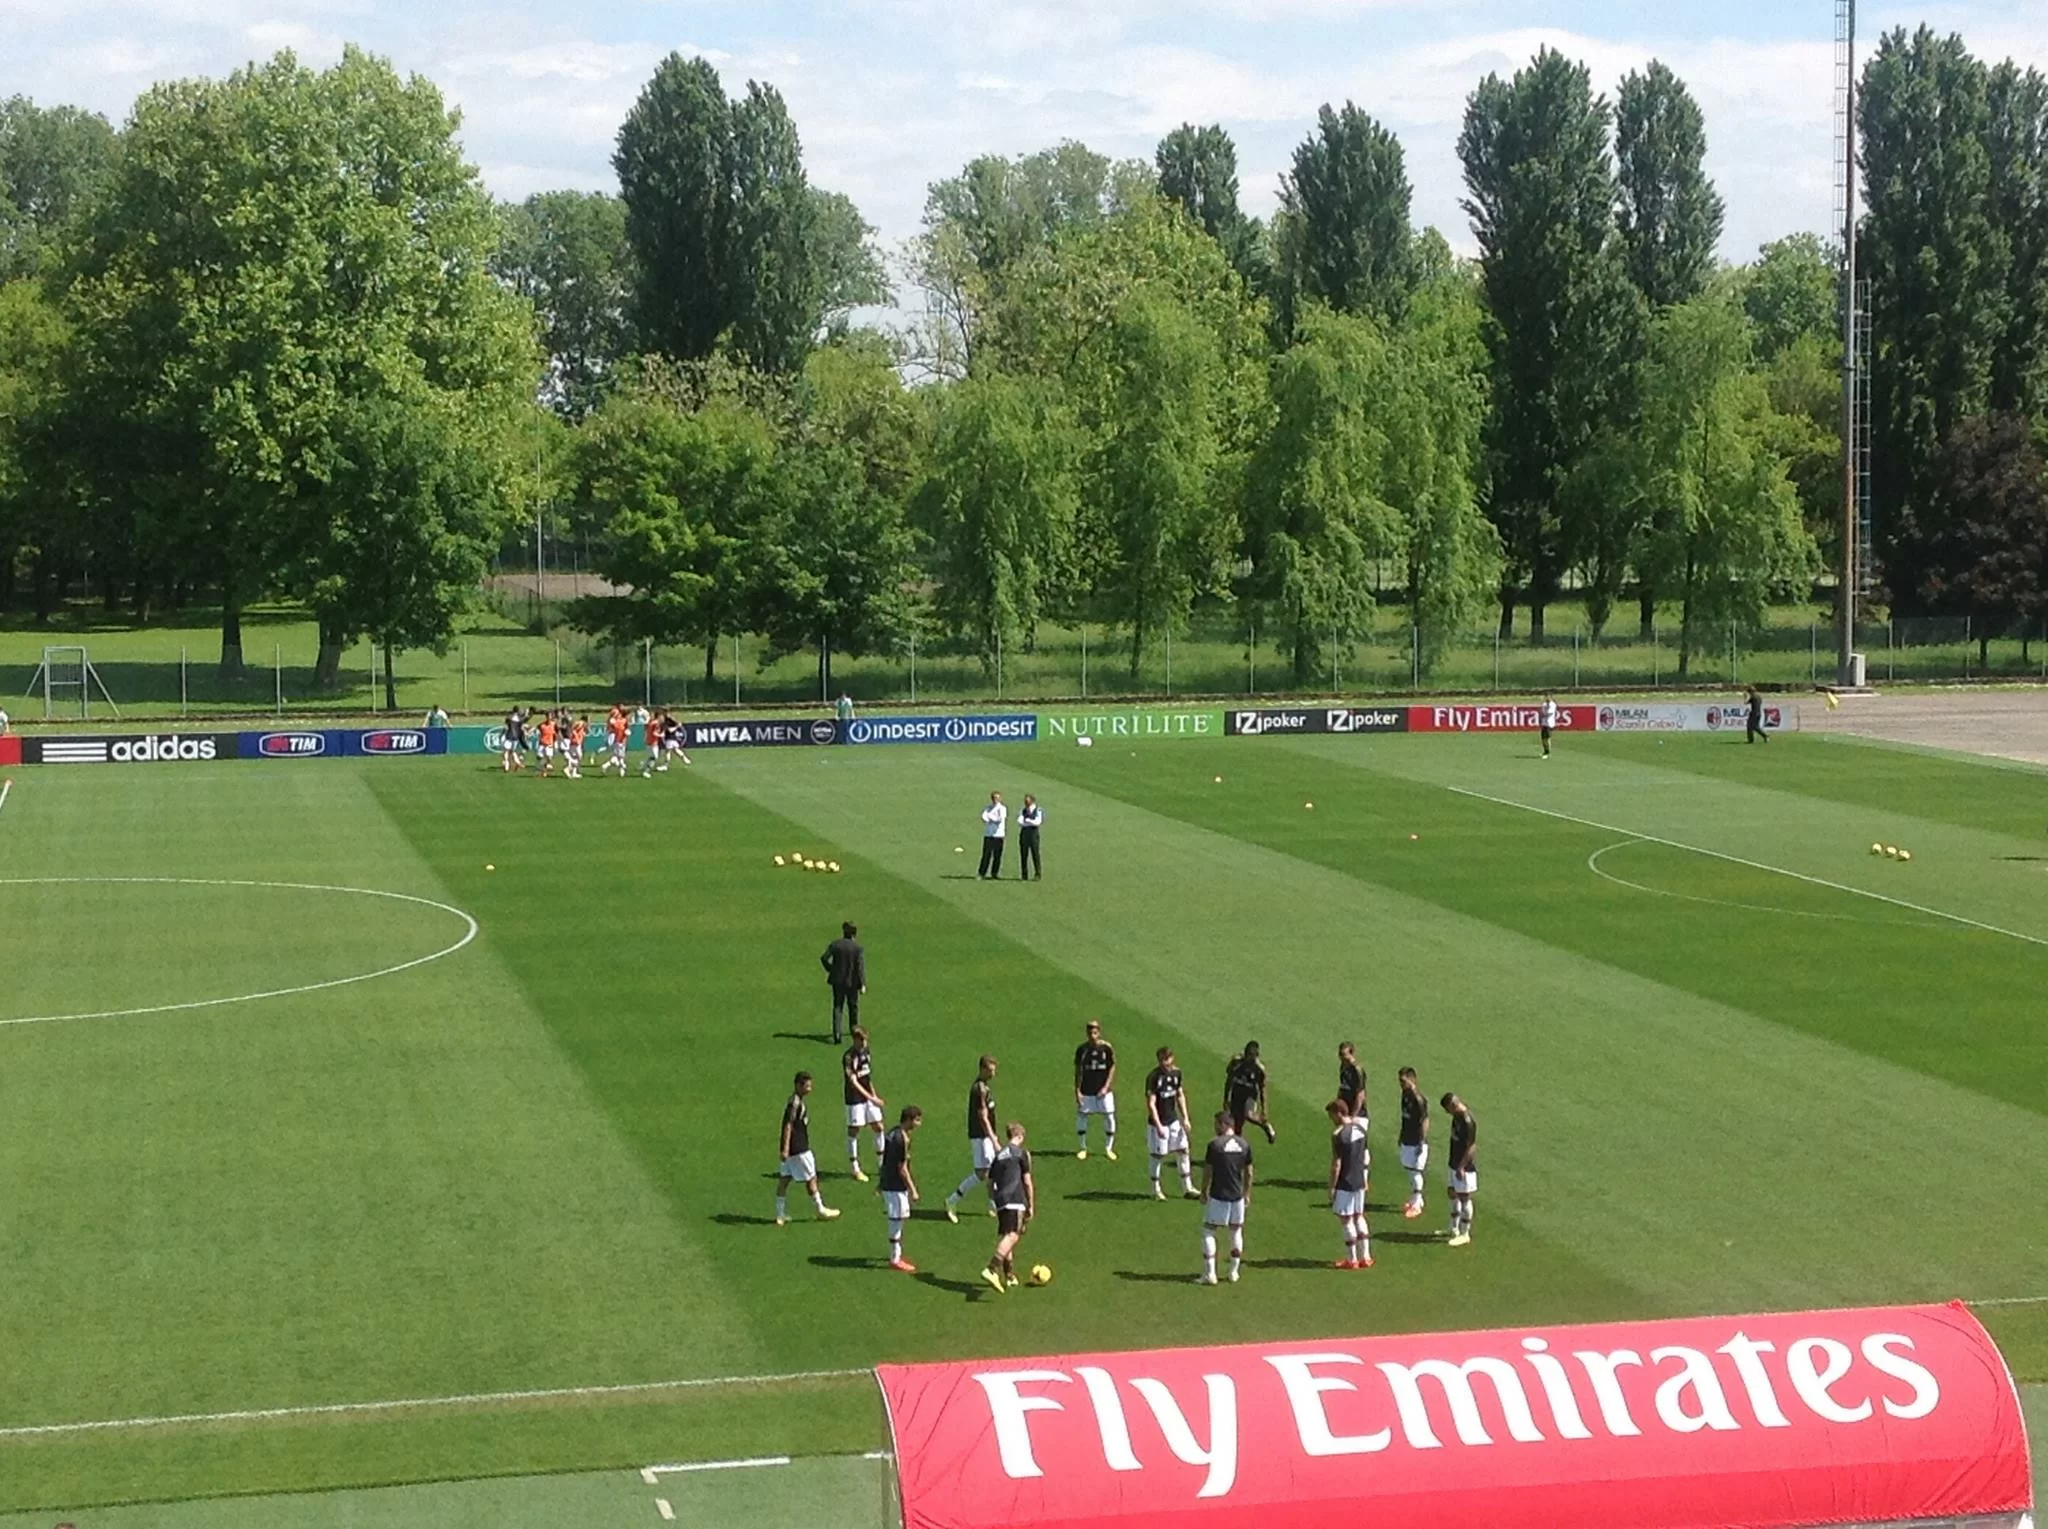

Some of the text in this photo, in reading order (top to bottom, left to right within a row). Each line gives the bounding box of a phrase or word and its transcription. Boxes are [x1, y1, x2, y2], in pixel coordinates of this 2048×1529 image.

[1049, 715, 1210, 736] NUTRILITE
[1434, 706, 1572, 731] Fly Emiraes
[289, 737, 317, 751] TIM
[391, 735, 418, 749] TIM
[696, 727, 751, 743] NIVEA
[756, 726, 801, 741] MEN
[111, 735, 216, 760] adidas
[971, 1331, 1941, 1497] Fly Emirates
